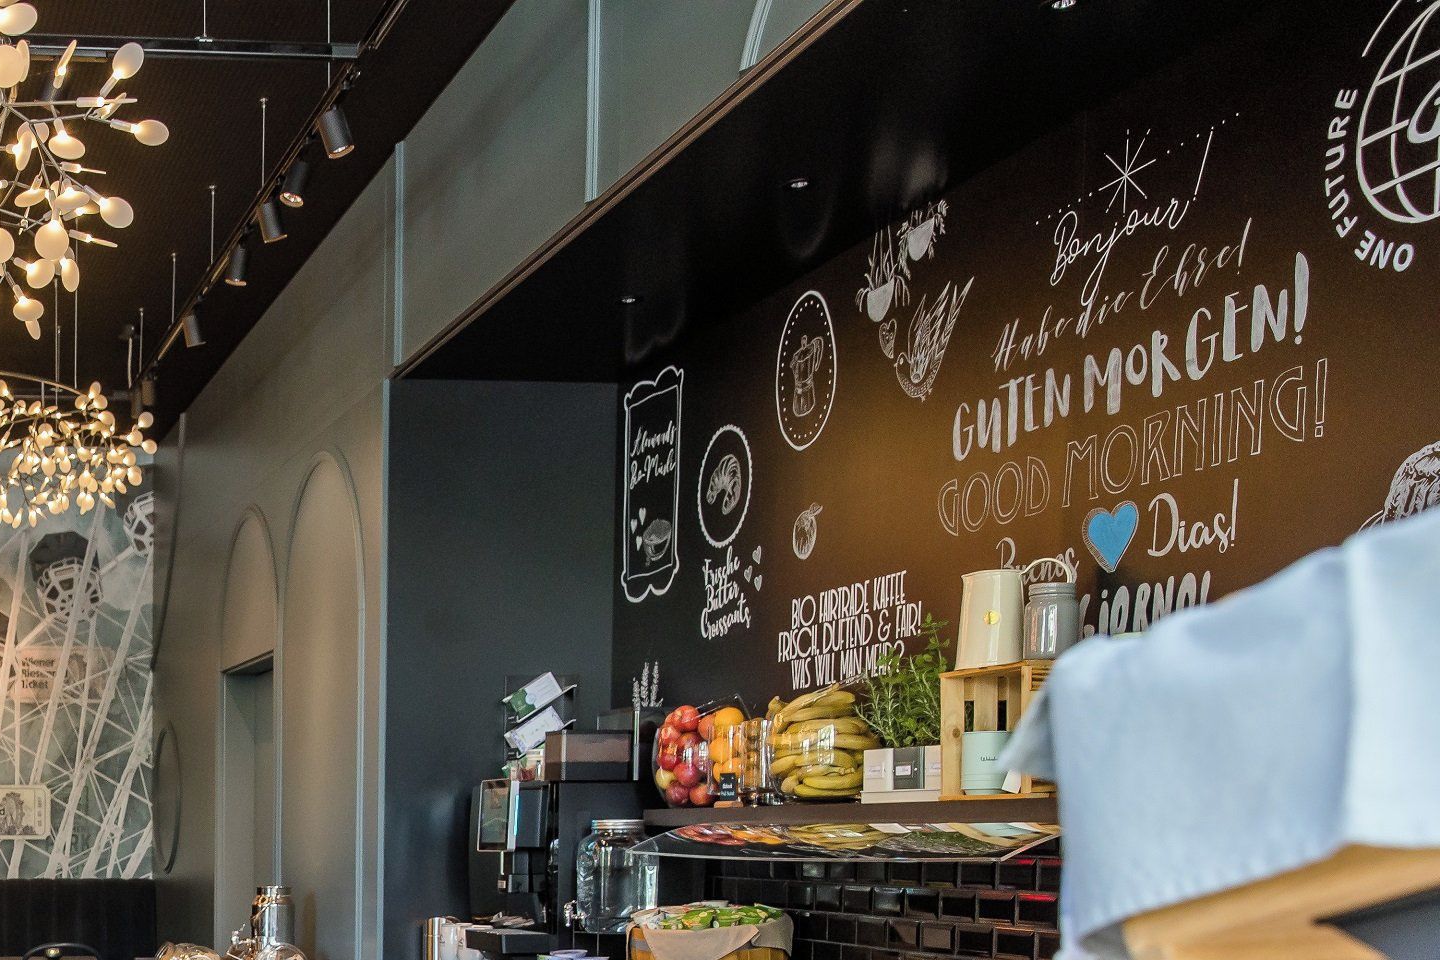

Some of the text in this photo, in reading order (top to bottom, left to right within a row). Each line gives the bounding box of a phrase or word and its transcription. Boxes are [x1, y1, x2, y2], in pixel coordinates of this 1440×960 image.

[1324, 89, 1414, 272] ONE FUTURE
[952, 251, 1310, 462] GUTEN MORGEN!
[936, 358, 1328, 537] GOOD MORNING!
[1147, 478, 1239, 557] Dias!
[702, 545, 740, 587] Frische
[701, 593, 751, 640] Croissants
[705, 581, 739, 612] Butter
[792, 570, 907, 630] BIO FAIRTRADE KAFFEE
[822, 614, 873, 655] DUFTEND
[877, 609, 891, 642] &
[895, 601, 922, 639] FAIR!
[791, 658, 811, 690] WAS
[814, 652, 836, 686] WILL
[840, 646, 863, 680] MAN
